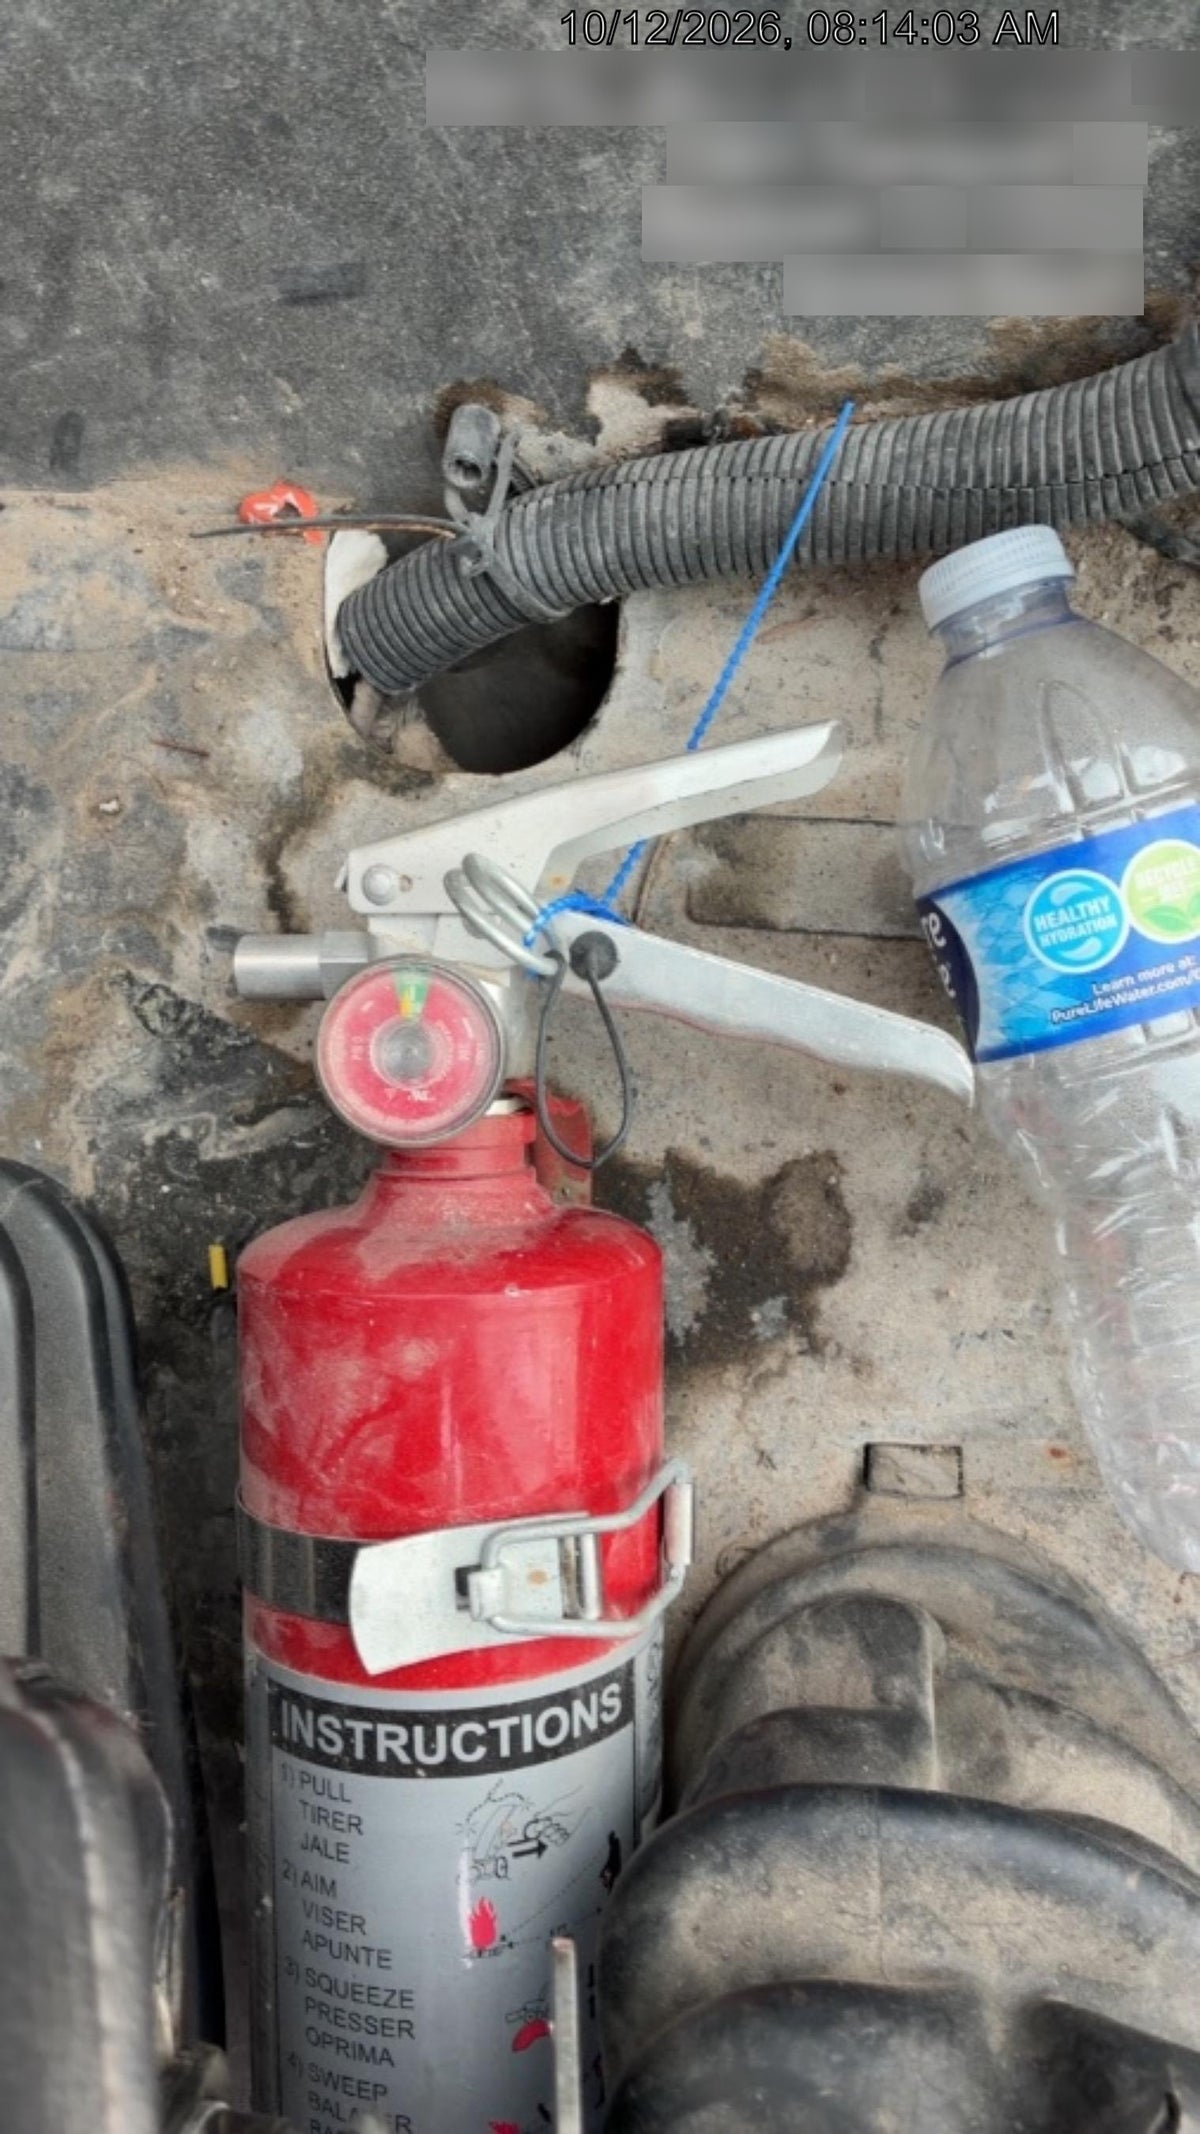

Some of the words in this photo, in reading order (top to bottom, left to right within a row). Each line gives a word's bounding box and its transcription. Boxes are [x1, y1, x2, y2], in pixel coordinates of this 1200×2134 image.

[1034, 895, 1110, 932] HEALTHY
[1038, 913, 1118, 948] HYDRATION
[1091, 975, 1135, 996] Learn
[1137, 962, 1176, 983] more
[280, 1682, 623, 1766] INSTRUCTIONS
[281, 1761, 295, 1789] 1)
[300, 1770, 352, 1803] PULL
[299, 1799, 364, 1836] TIRER
[301, 1832, 350, 1864] JALE
[301, 1870, 337, 1898] AIM
[302, 1899, 367, 1935] VISER
[303, 1929, 393, 1970] APUNTE
[305, 1967, 415, 2009] SQUEEZE
[305, 1996, 416, 2041] PRESSER
[305, 2026, 396, 2068] OPRIMA
[308, 2062, 388, 2101] SWEEP
[308, 2091, 413, 2134] BALAR
